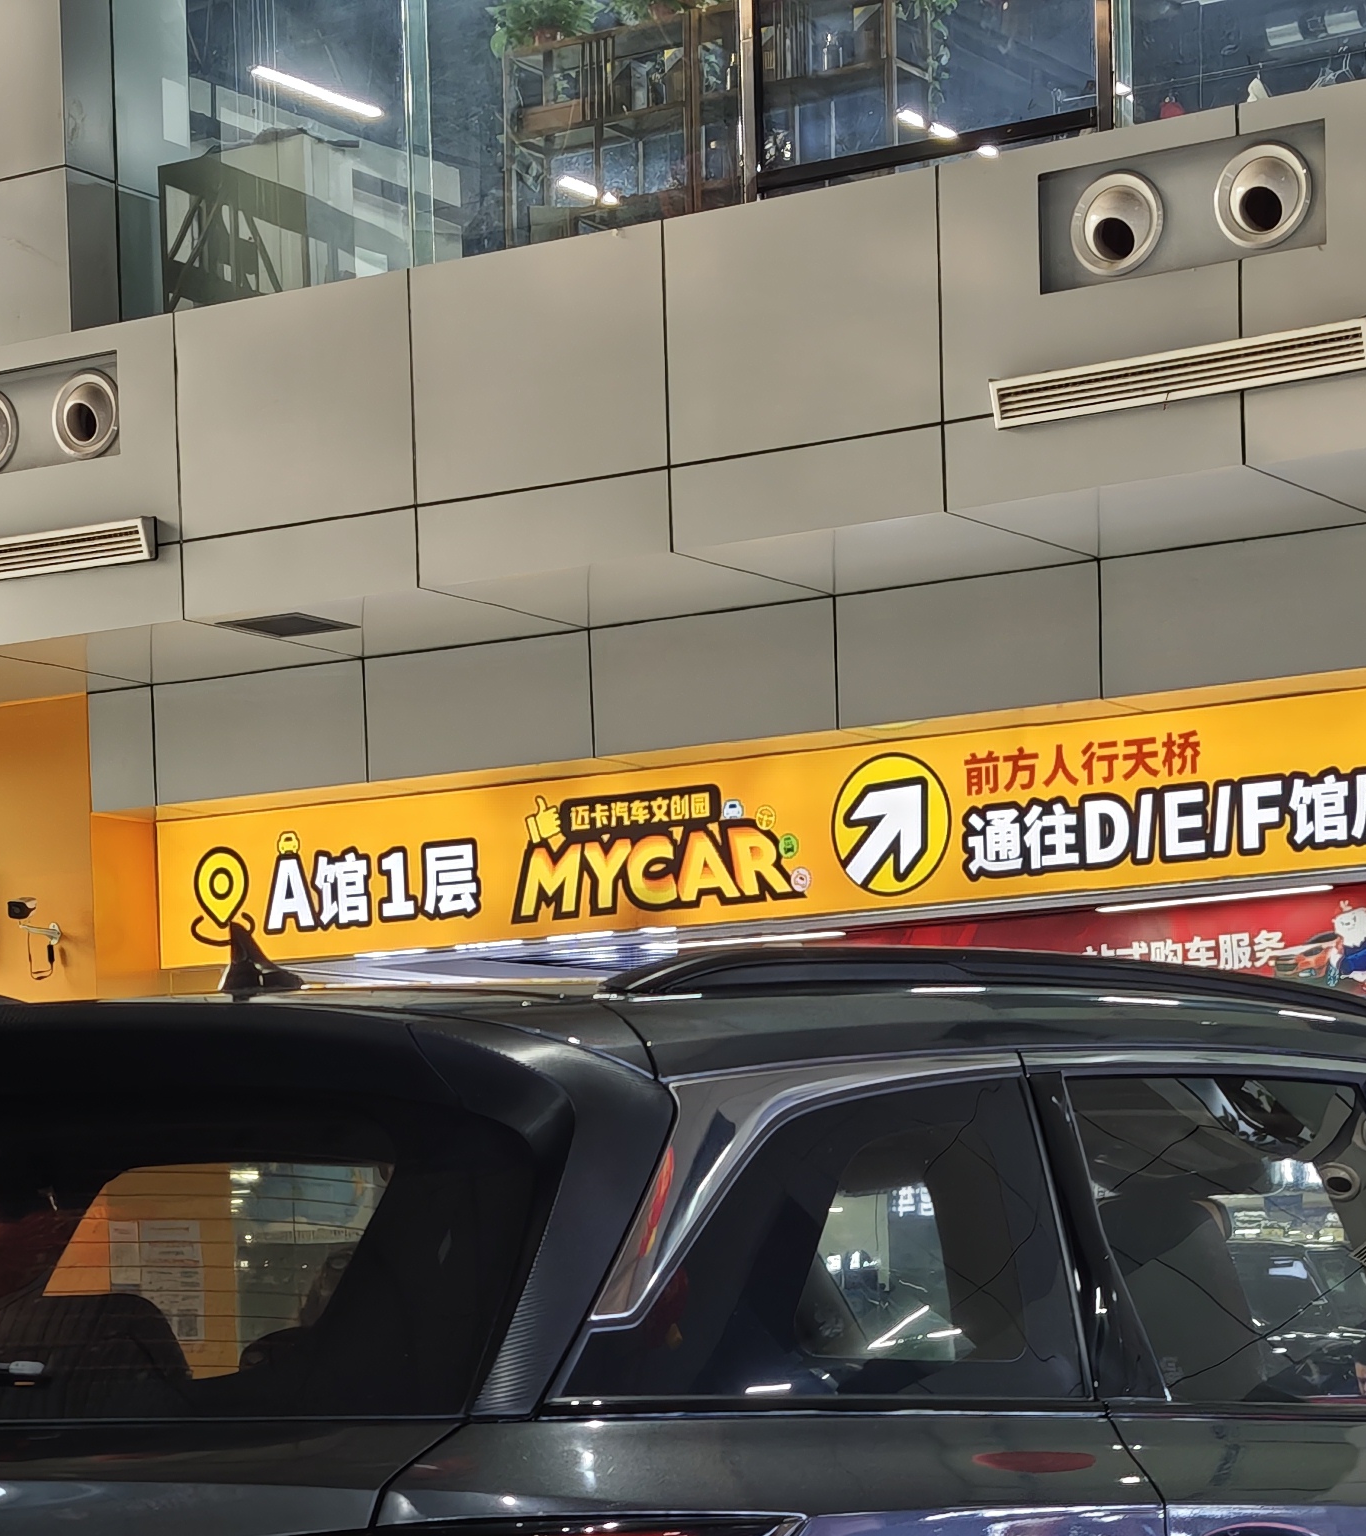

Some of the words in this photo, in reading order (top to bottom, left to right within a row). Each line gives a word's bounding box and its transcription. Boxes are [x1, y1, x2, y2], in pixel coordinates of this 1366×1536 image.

[963, 730, 1201, 796] 前方人行天桥
[570, 791, 711, 832] 迈卡汽车文创园
[267, 843, 478, 934] A馆1层
[516, 826, 800, 921] MYCAR
